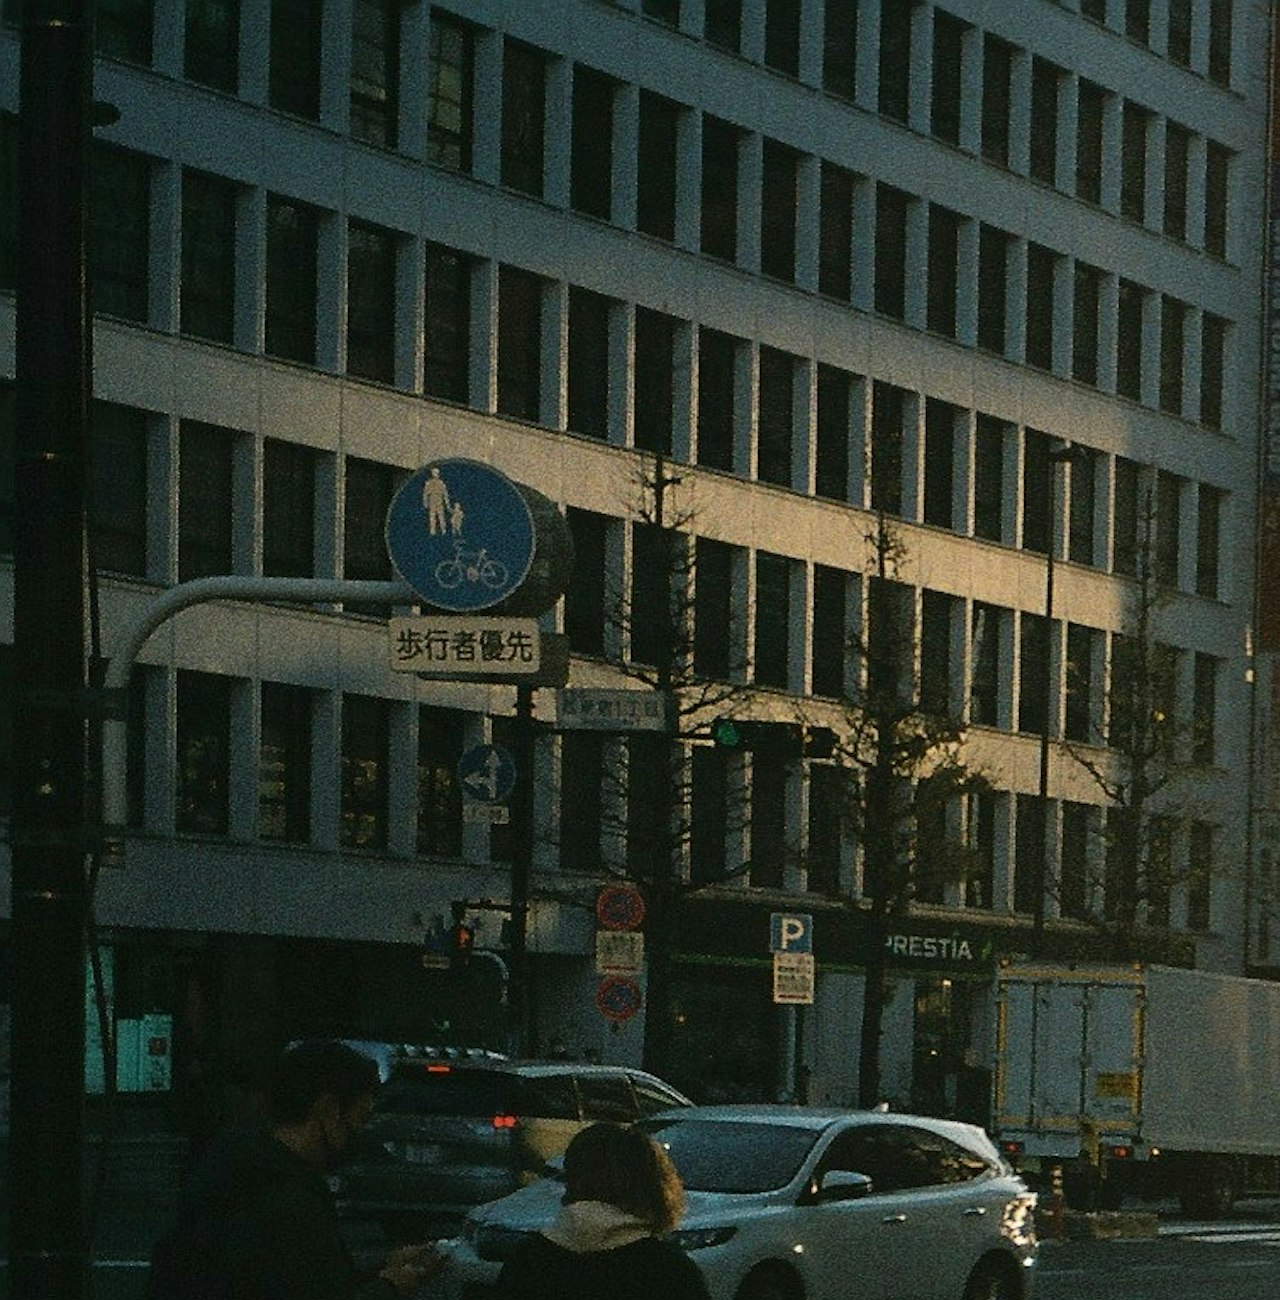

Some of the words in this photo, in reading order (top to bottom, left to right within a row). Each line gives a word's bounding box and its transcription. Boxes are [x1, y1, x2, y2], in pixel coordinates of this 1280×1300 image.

[396, 628, 533, 662] 歩行者優先
[780, 918, 805, 950] P
